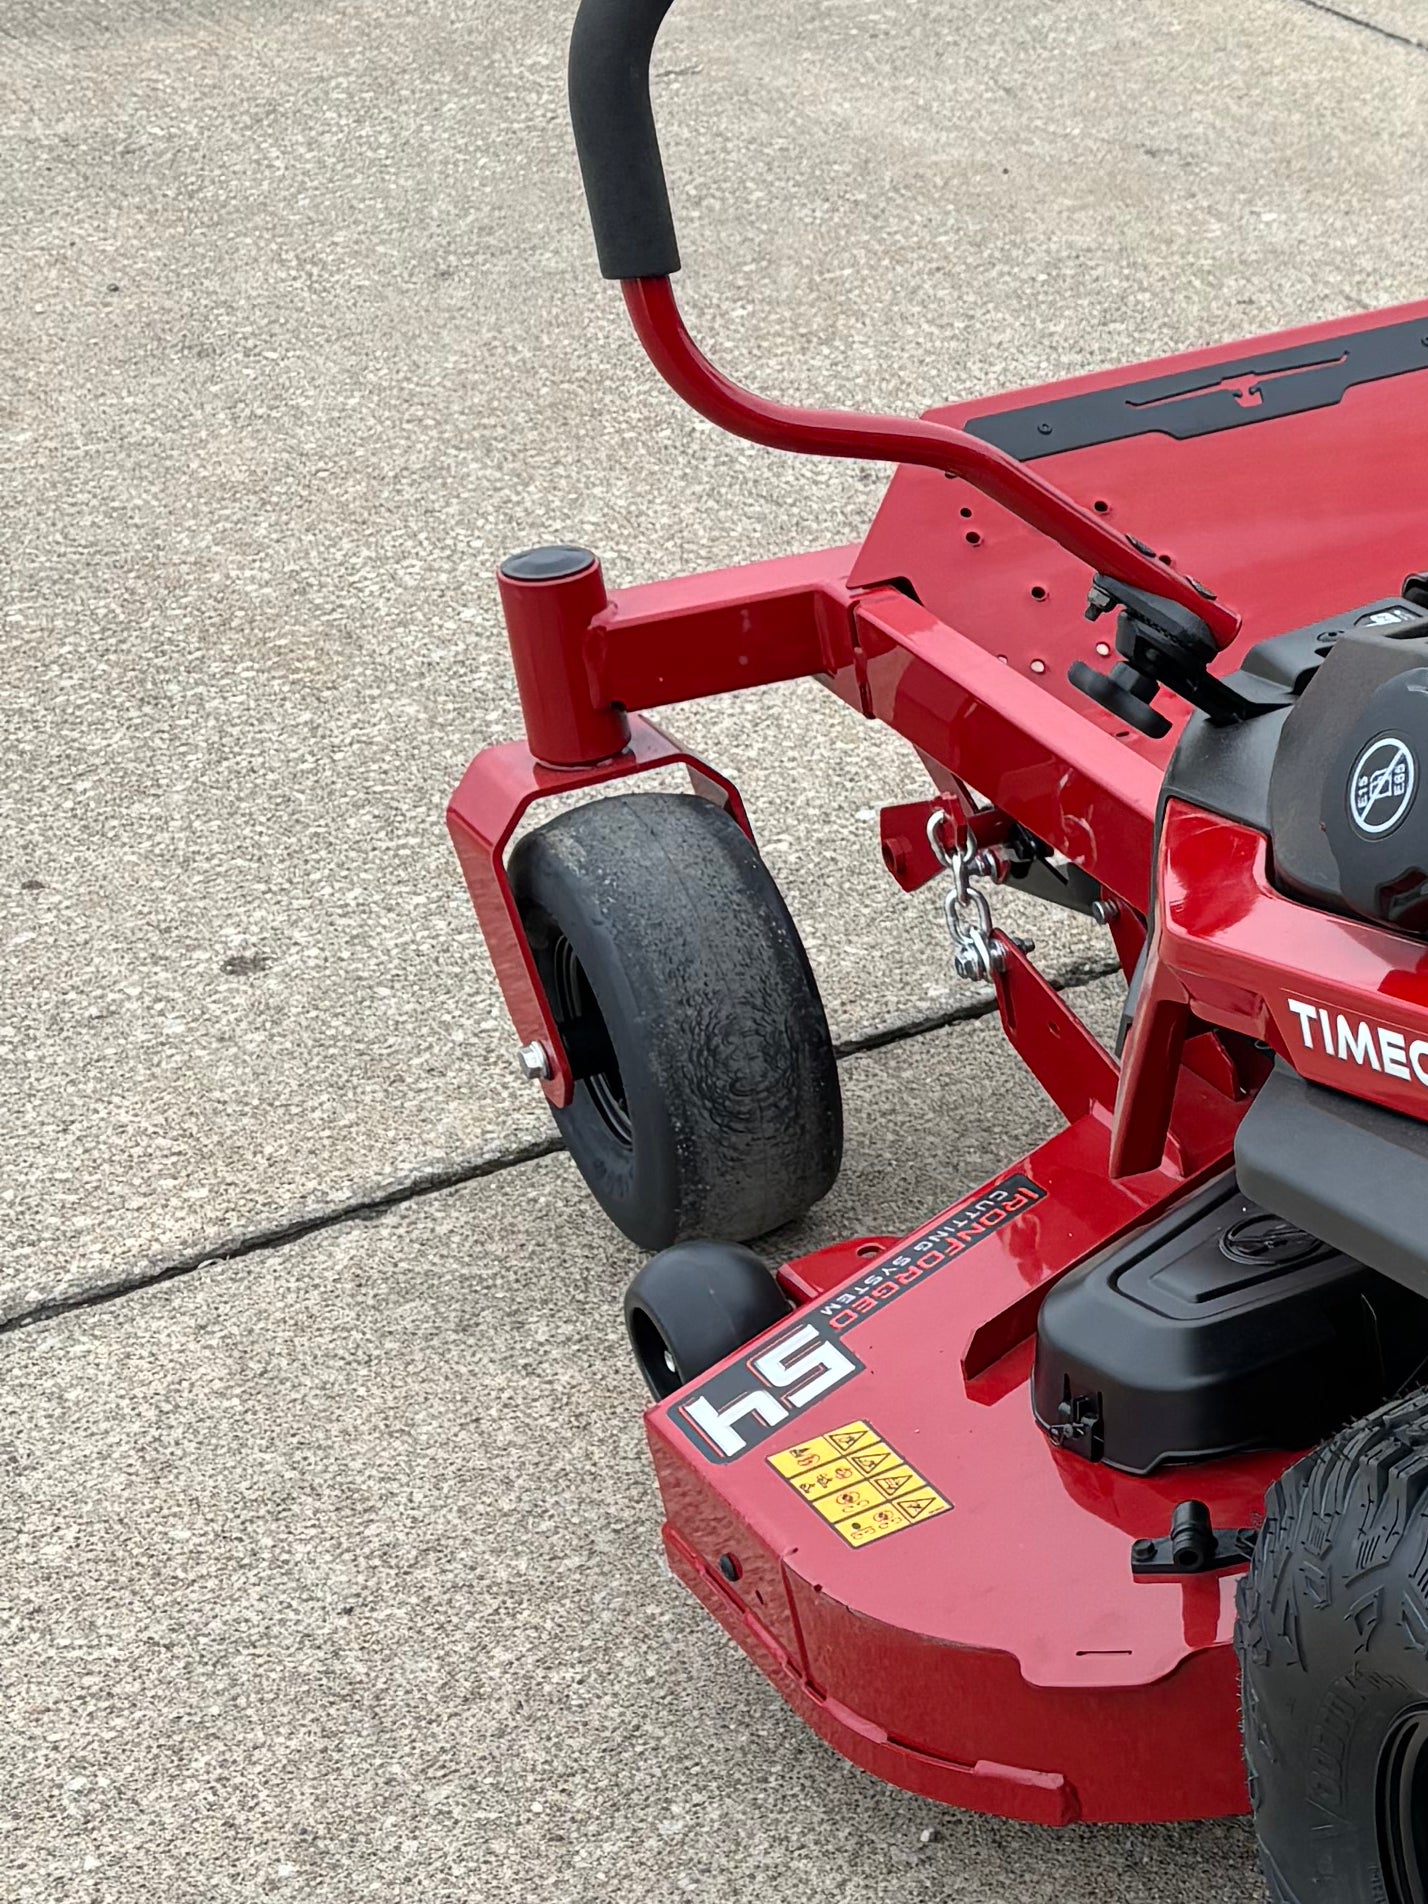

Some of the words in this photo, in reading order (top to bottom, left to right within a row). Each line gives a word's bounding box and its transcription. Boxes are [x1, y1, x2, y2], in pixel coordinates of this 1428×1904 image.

[829, 1187, 1040, 1333] IRONFORGED
[913, 1190, 1010, 1252] CUTTING
[820, 1255, 912, 1316] SYSTEM
[680, 1322, 859, 1462] 54
